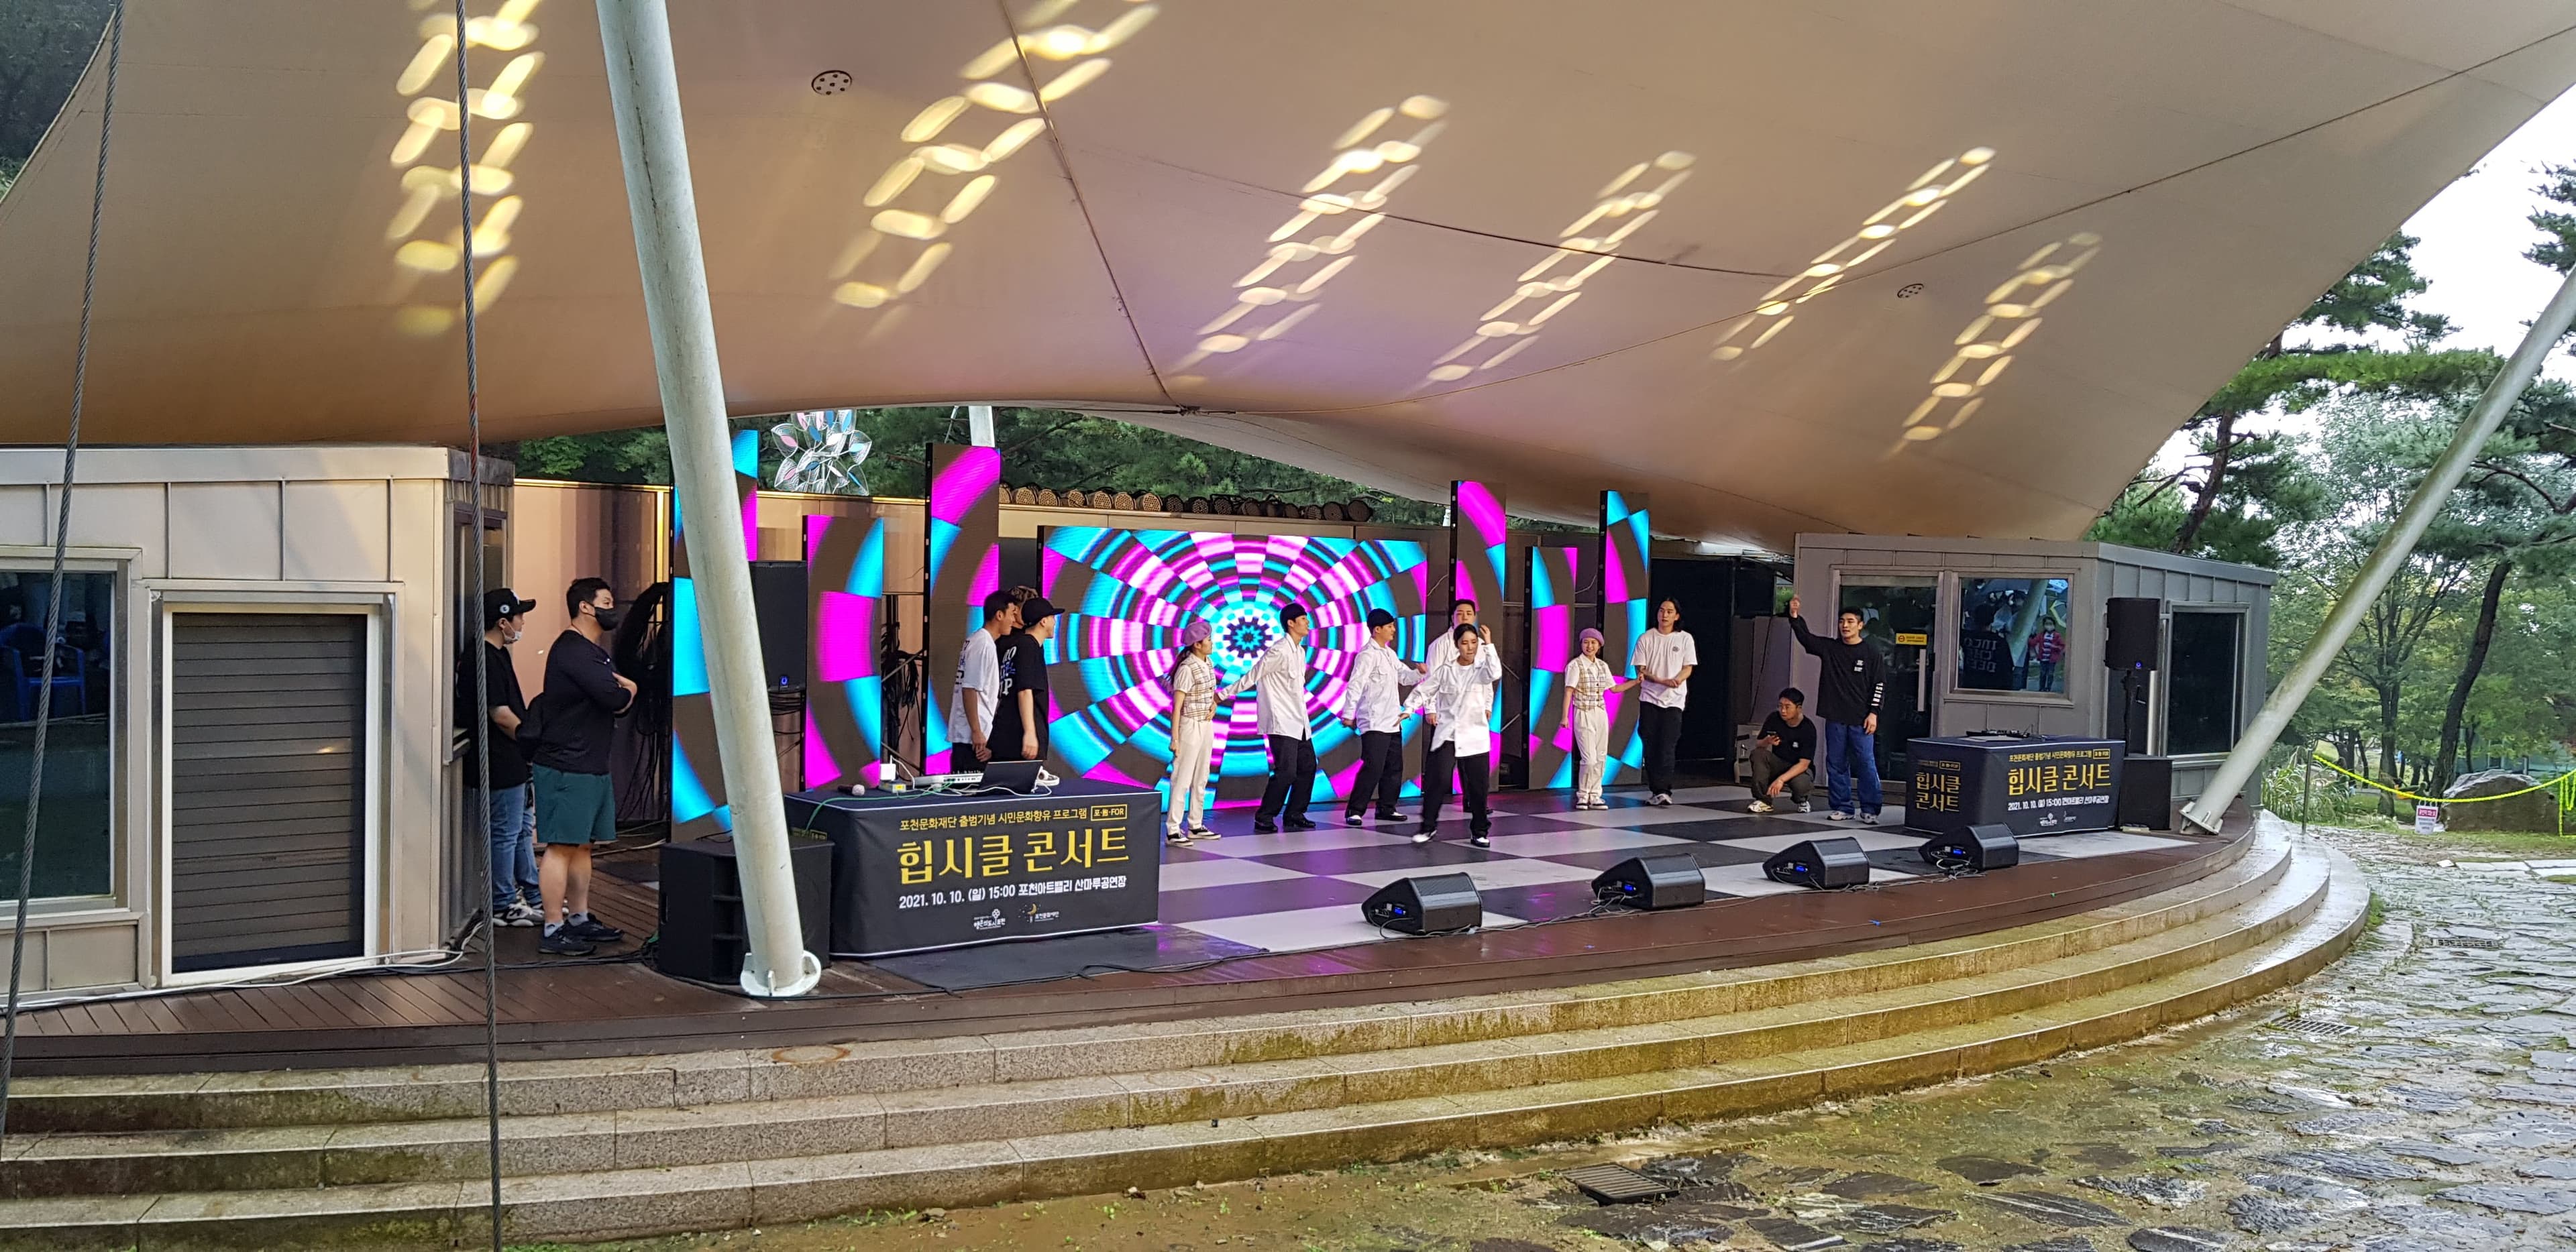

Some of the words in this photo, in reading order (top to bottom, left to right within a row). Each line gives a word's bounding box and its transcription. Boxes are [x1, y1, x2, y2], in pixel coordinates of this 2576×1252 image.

[1915, 772, 1961, 793] 힙시클
[2008, 766, 2059, 795] 힙시클
[2062, 764, 2111, 791] 콘서트
[1915, 791, 1960, 811] 콘서트
[2046, 798, 2061, 807] 15:00
[900, 816, 957, 832] 포천문화재단
[959, 813, 996, 828] 출범기념
[998, 809, 1051, 823] 시민문화향유
[1053, 808, 1087, 819] 프로그램
[897, 835, 1013, 885] 힙시클
[1024, 826, 1129, 872] 콘서트
[899, 894, 928, 909] 2021.
[931, 892, 947, 905] 10.
[949, 890, 965, 903] 10.
[968, 887, 985, 902] (일)
[989, 884, 1016, 899] 15:00
[1018, 880, 1073, 896] 포천아트밸리
[1074, 875, 1127, 892] 산마루공연장
